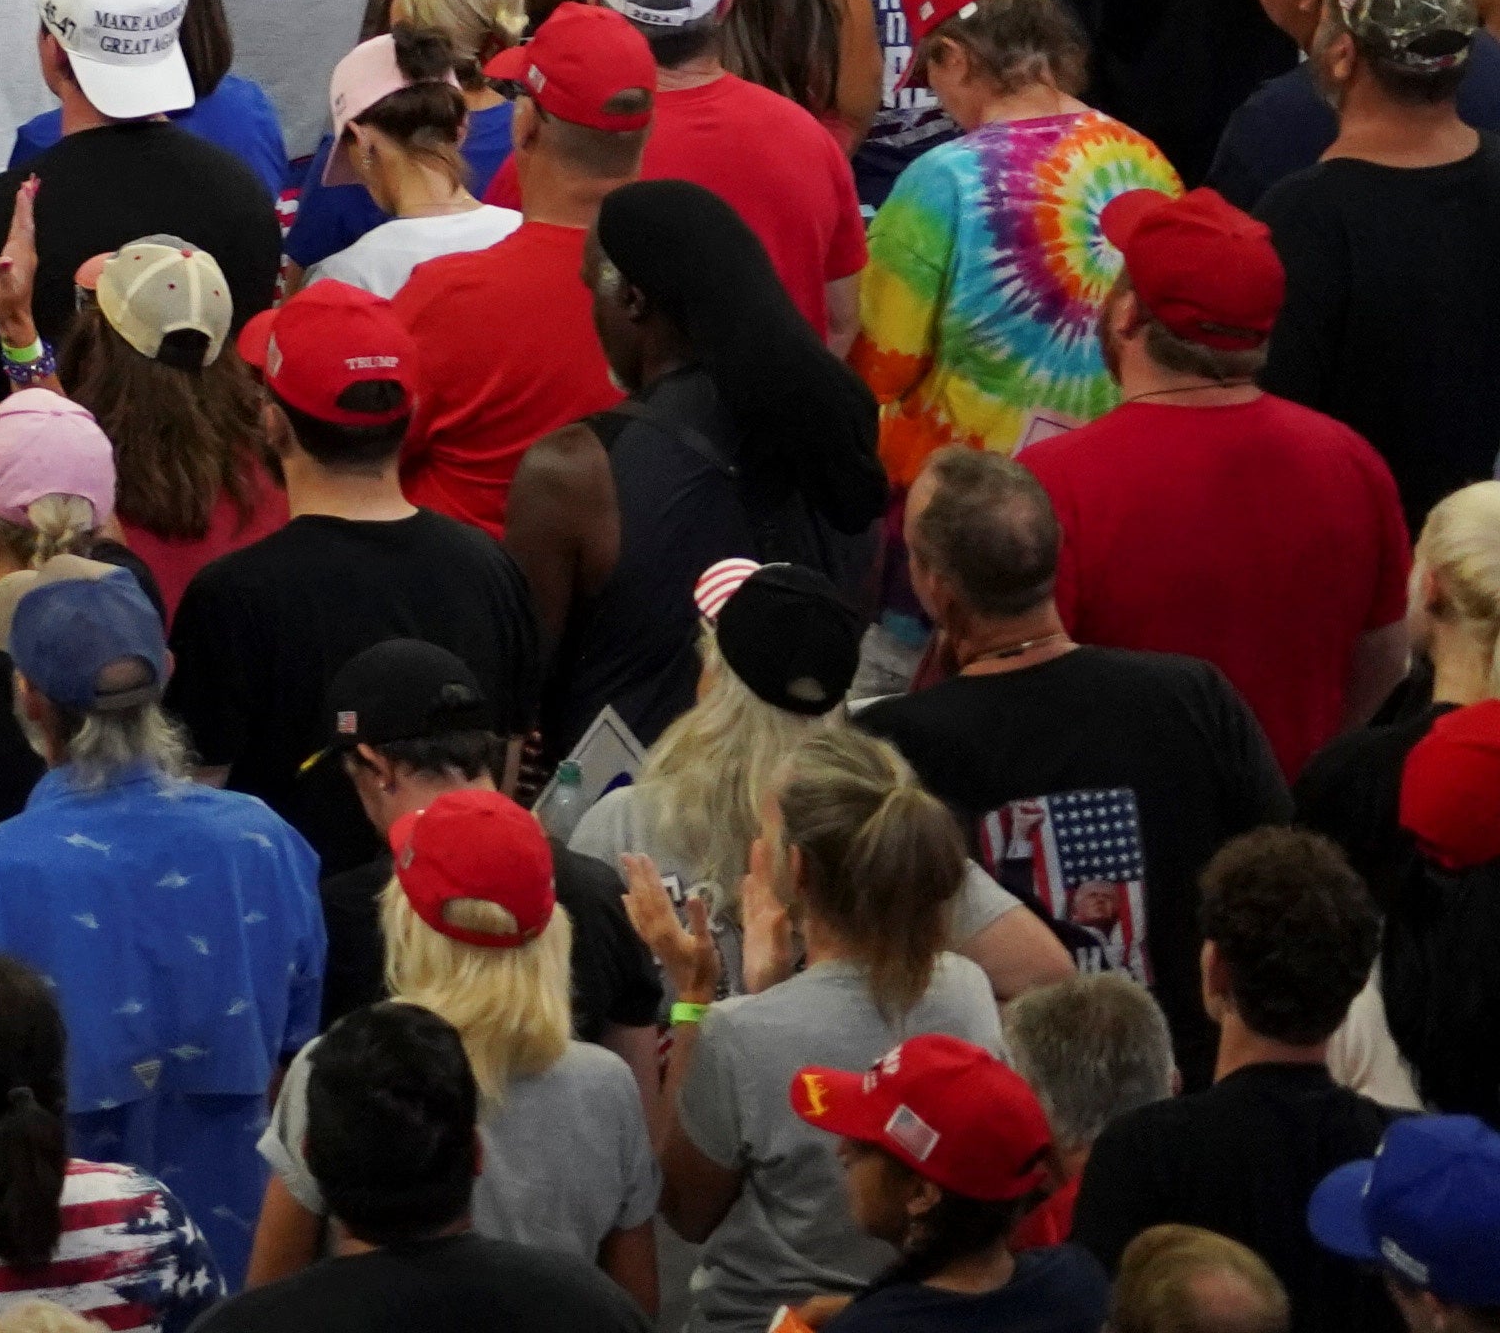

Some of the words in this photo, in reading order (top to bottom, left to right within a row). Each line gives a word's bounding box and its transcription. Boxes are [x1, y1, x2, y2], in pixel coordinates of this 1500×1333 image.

[96, 10, 139, 31] MAKE
[143, 1, 184, 31] AMER
[633, 9, 671, 24] 2024
[101, 35, 149, 55] GREAT
[345, 355, 399, 370] TRUMP
